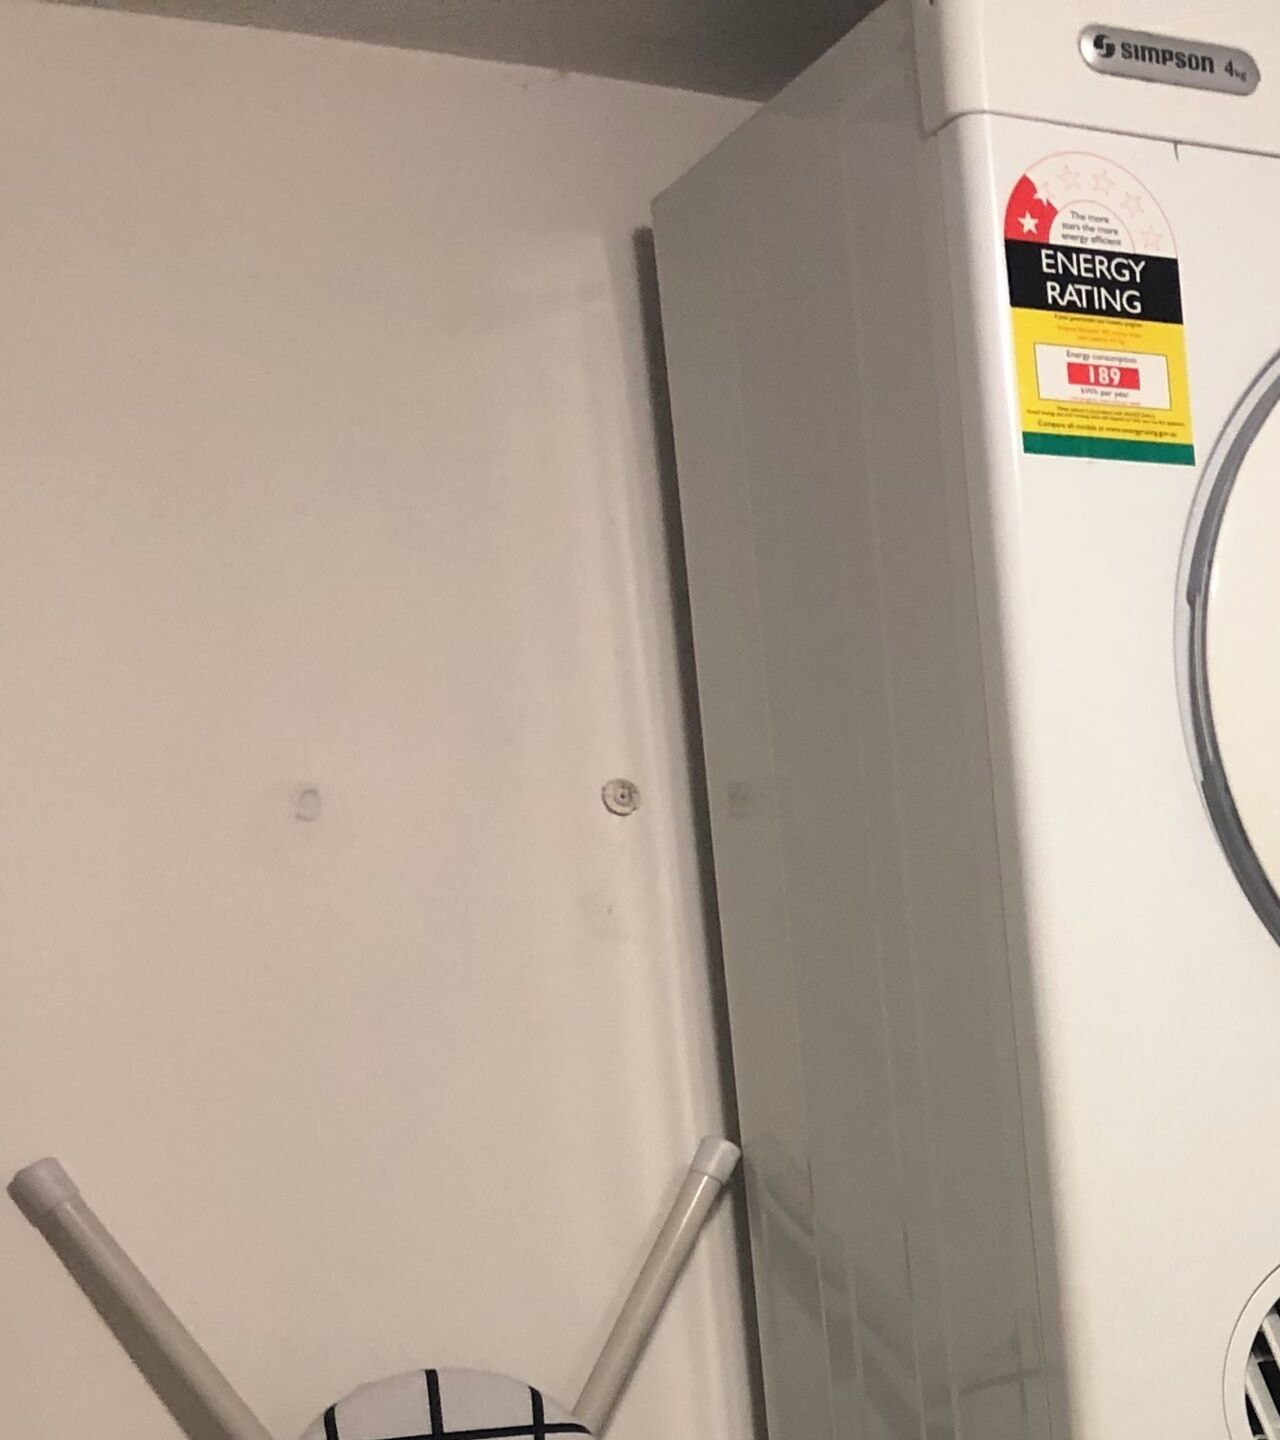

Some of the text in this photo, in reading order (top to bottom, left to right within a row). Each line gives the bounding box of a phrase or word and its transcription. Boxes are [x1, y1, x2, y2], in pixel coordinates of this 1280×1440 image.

[1120, 42, 1214, 73] SIMPSON
[1071, 210, 1110, 224] The more
[1082, 224, 1096, 232] the
[1097, 227, 1119, 236] more
[1061, 233, 1122, 246] energy efficient
[1040, 248, 1146, 284] ENERGY
[1046, 280, 1142, 314] RATING
[1066, 350, 1138, 365] Energy consumption
[1088, 365, 1121, 386] 189
